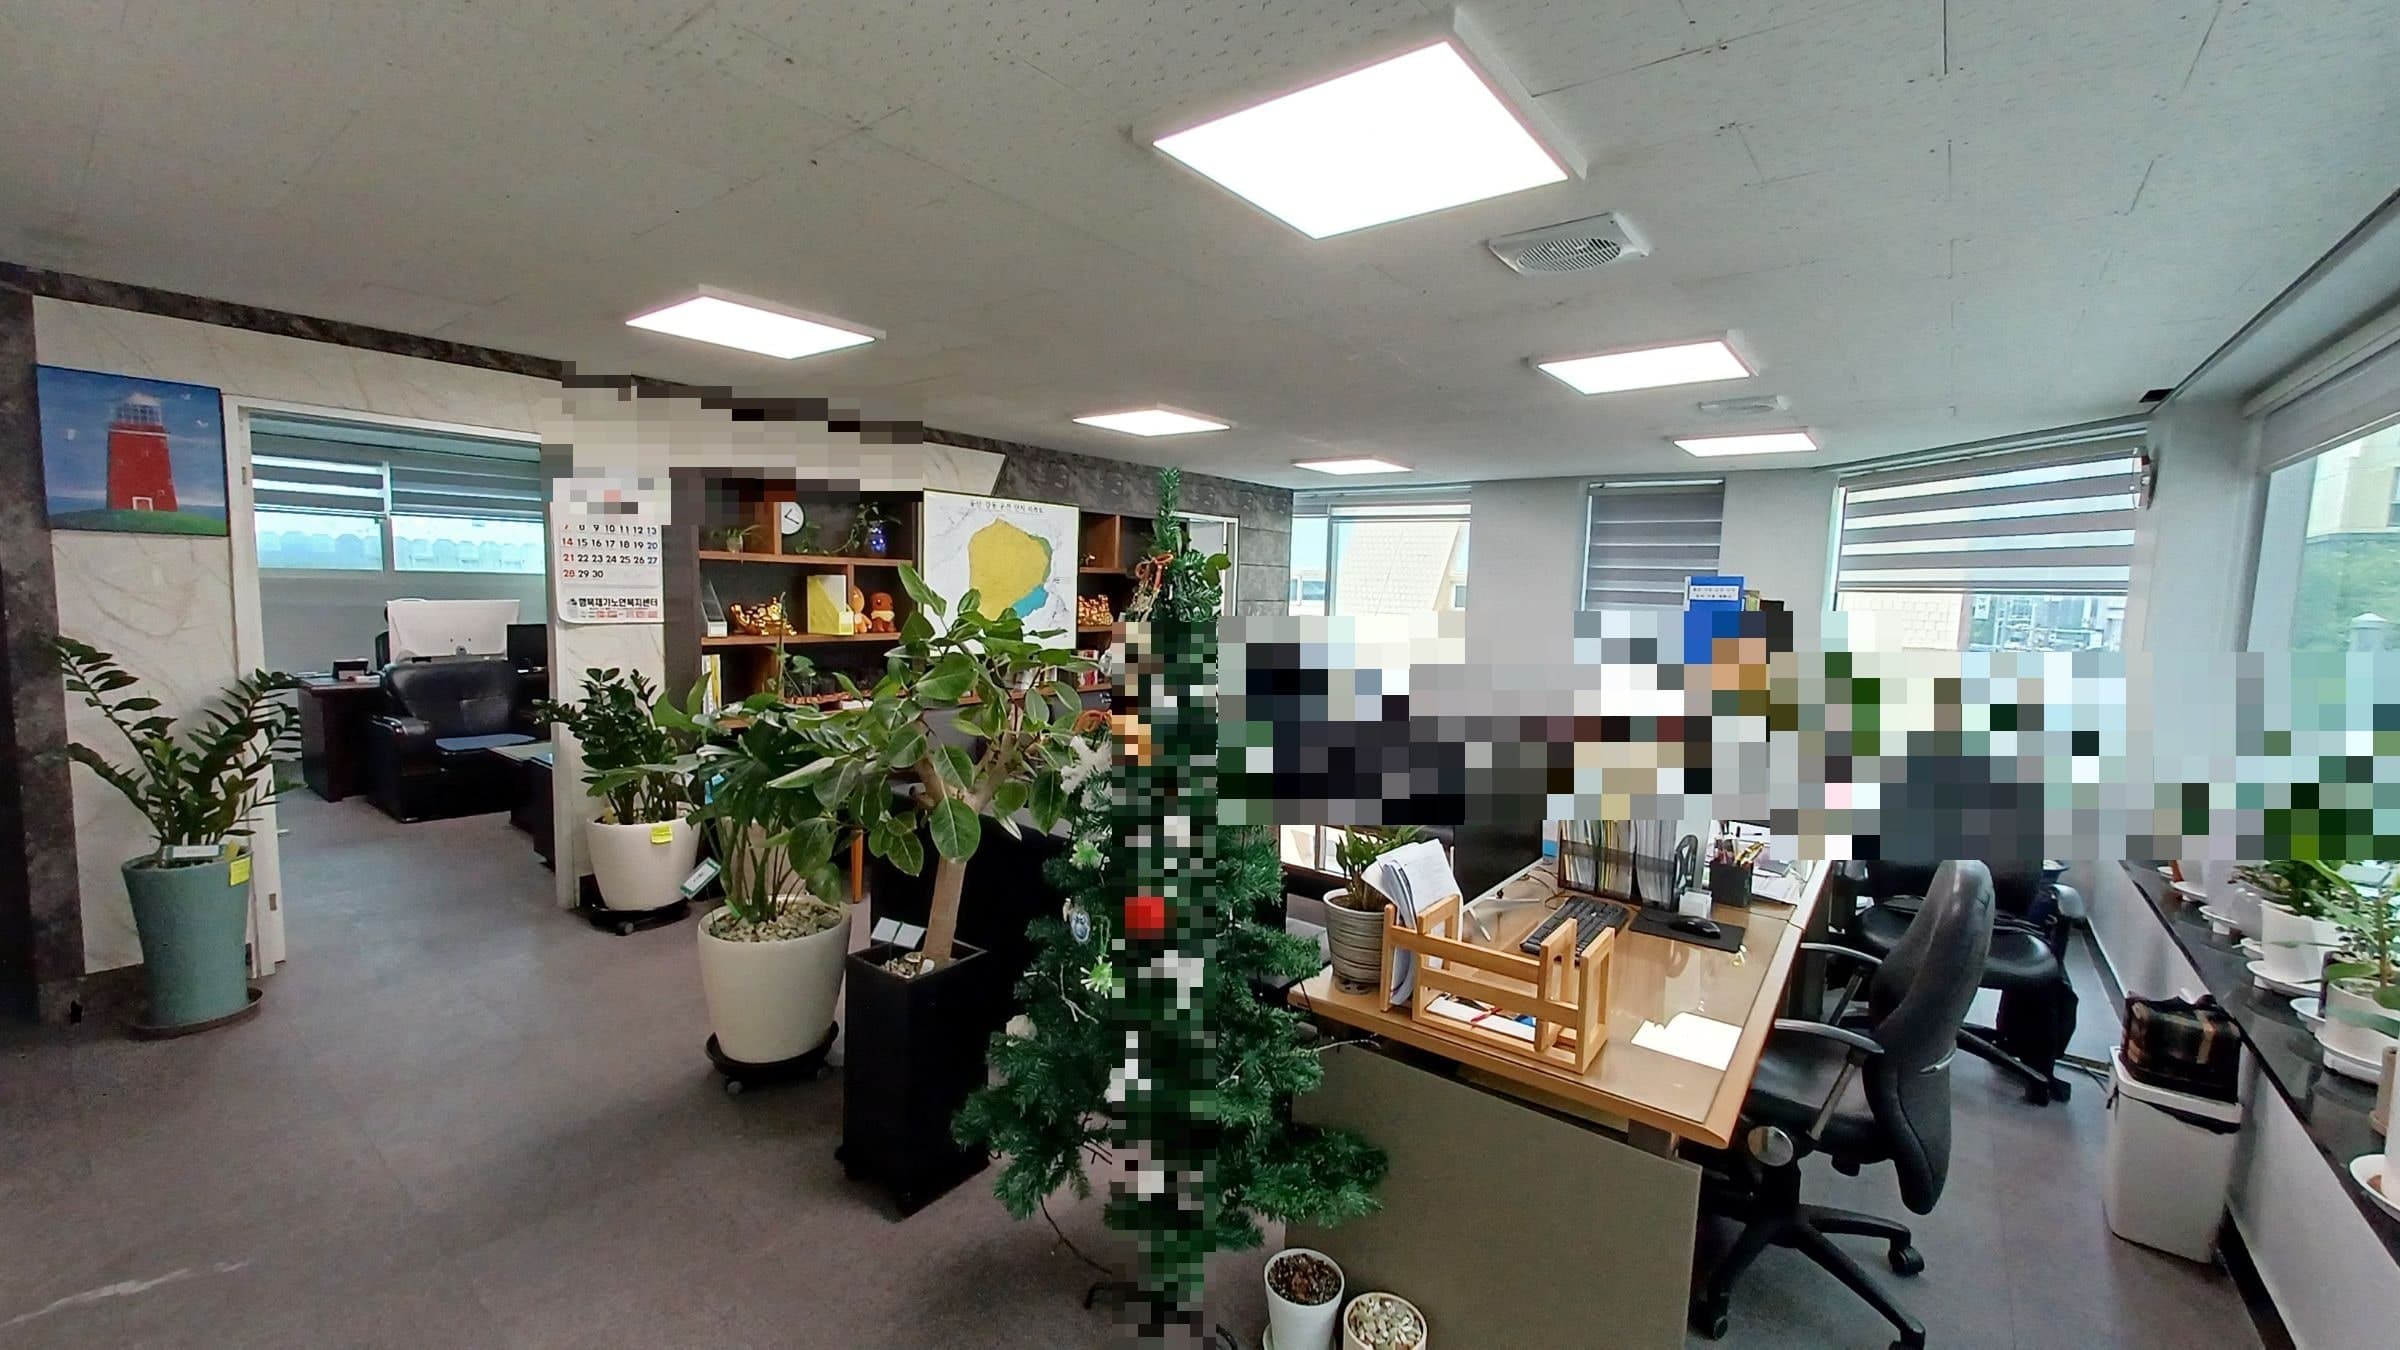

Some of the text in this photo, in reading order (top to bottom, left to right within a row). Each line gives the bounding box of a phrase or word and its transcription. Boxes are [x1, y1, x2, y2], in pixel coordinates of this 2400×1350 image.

[605, 524, 615, 532] 10
[619, 525, 629, 534] 11
[633, 526, 643, 534] 12
[646, 526, 657, 536] 13
[562, 537, 573, 546] 14
[577, 538, 588, 546] 15
[591, 539, 601, 548] 16
[619, 540, 630, 548] 18
[646, 541, 657, 550] 20
[563, 553, 658, 564] 21 22 23 24 25 26 27
[563, 569, 575, 578] 28
[577, 569, 589, 578] 29
